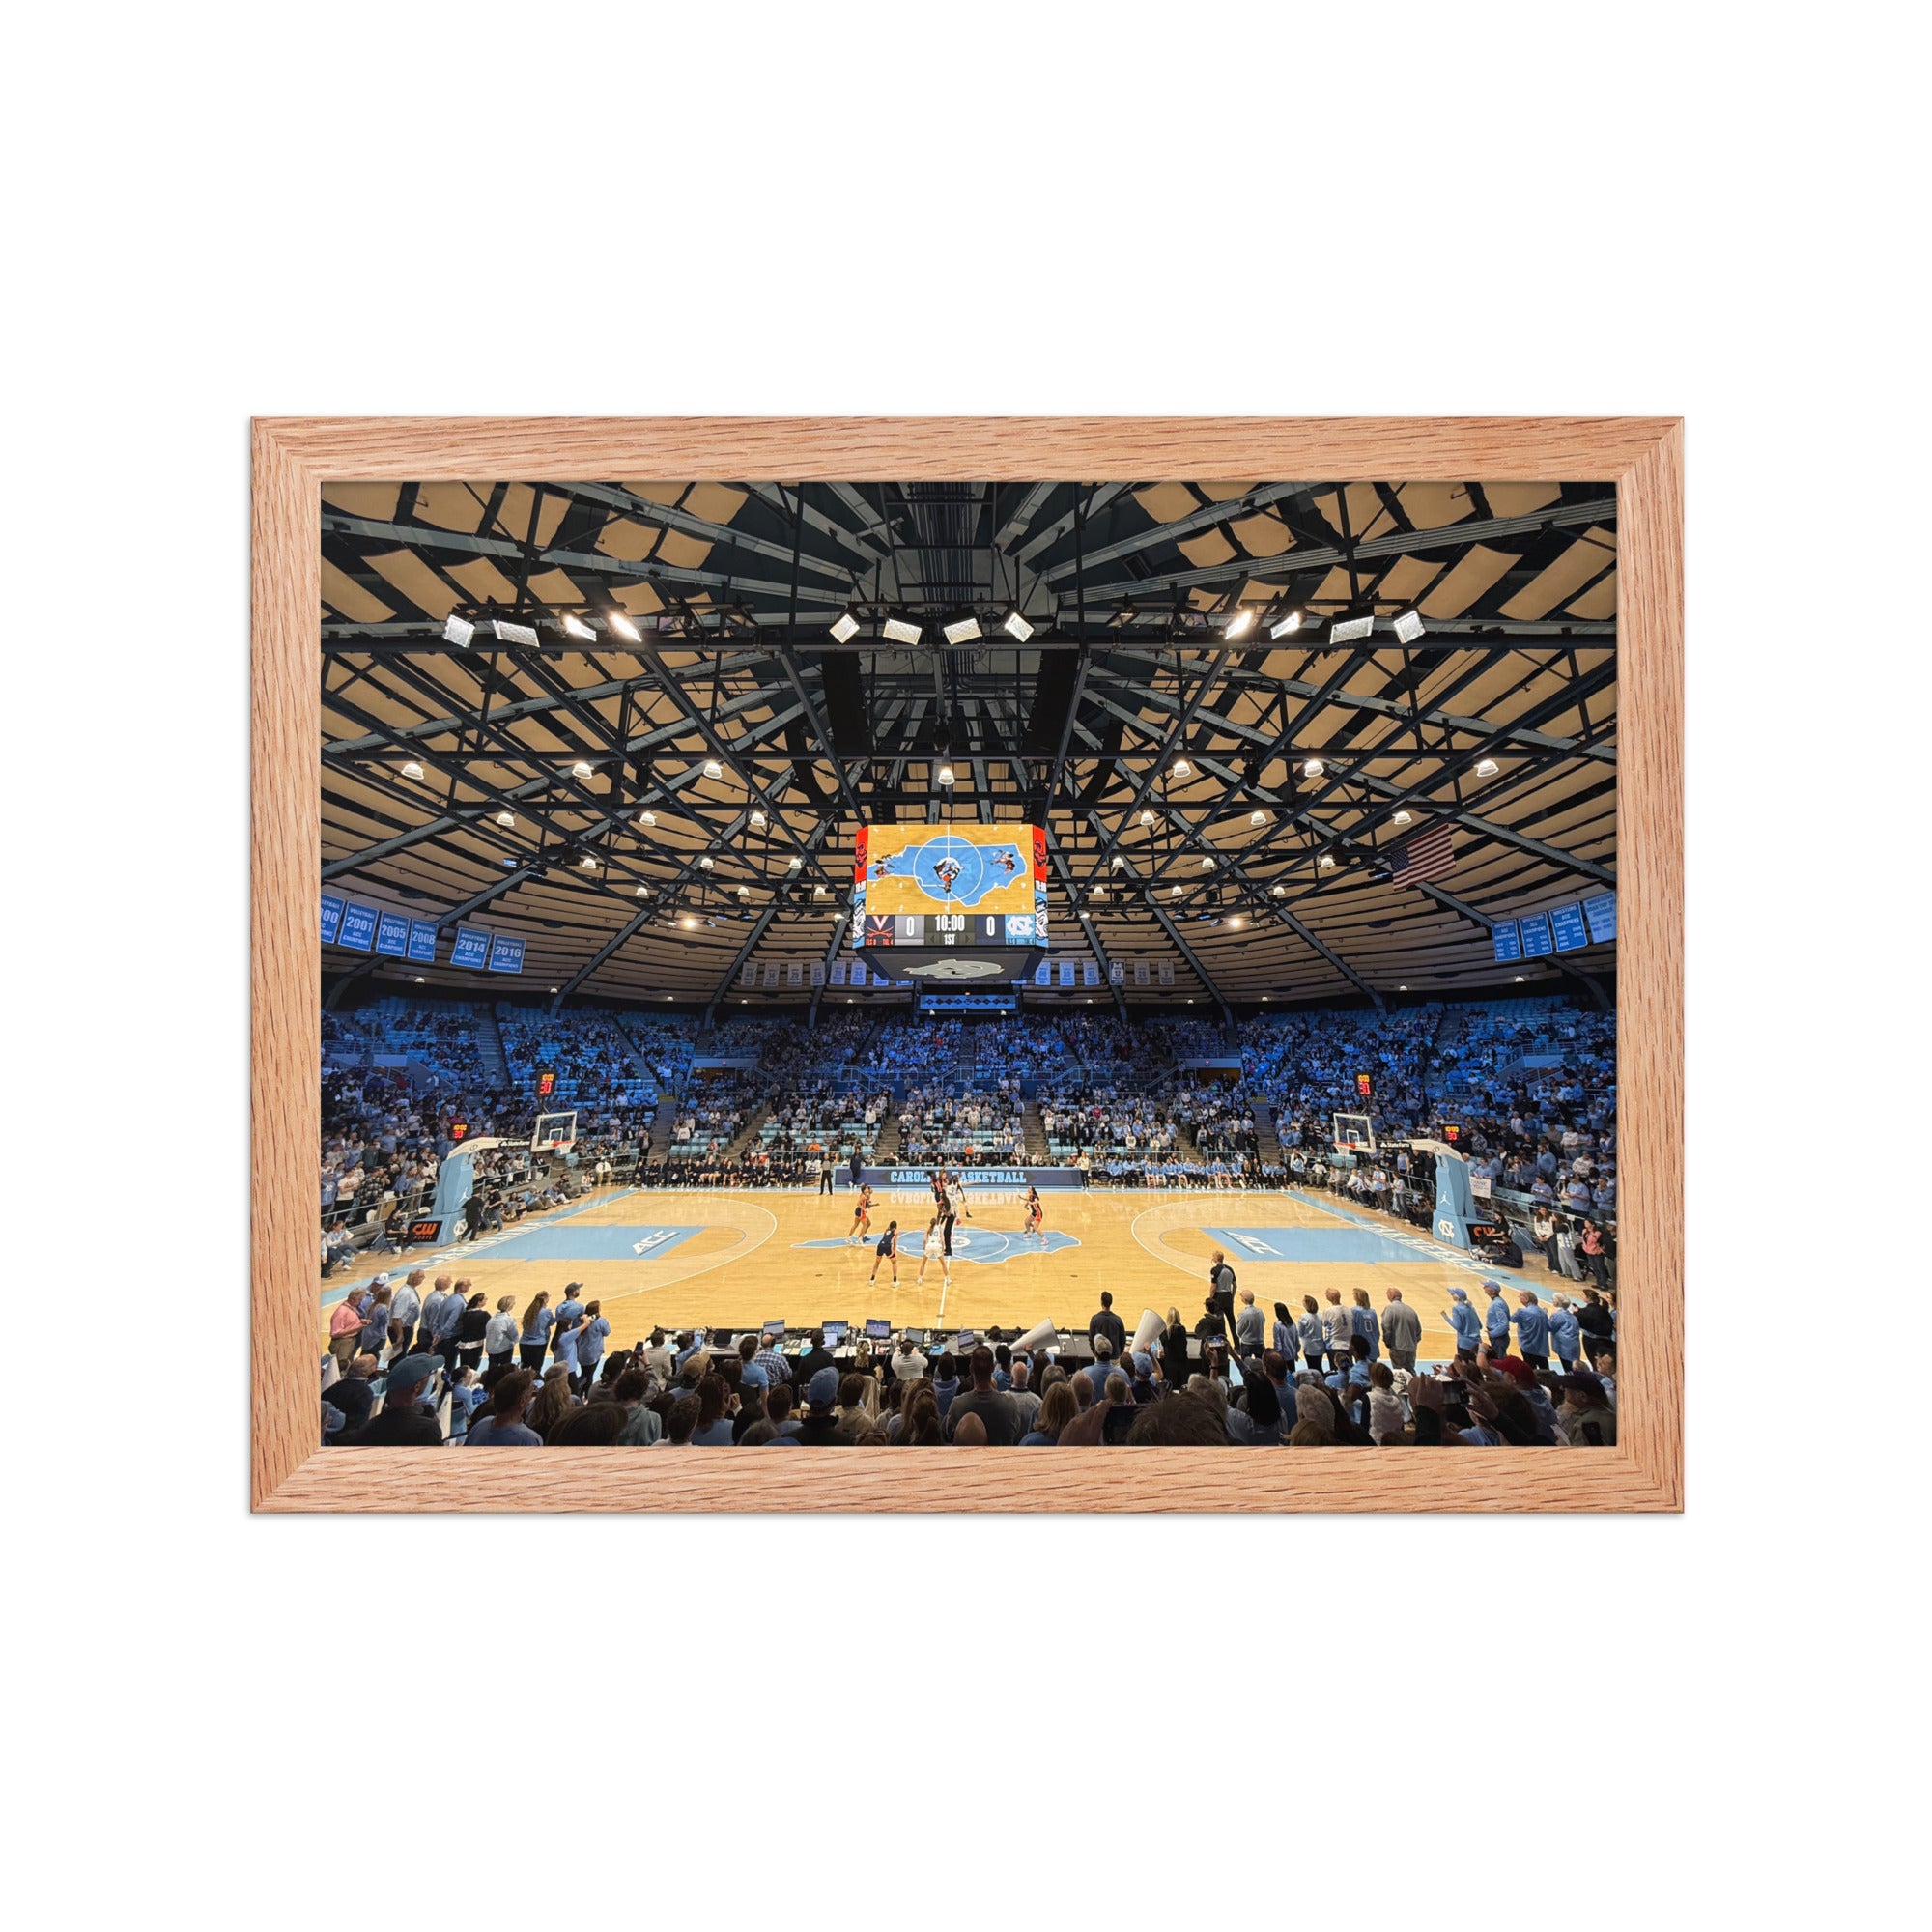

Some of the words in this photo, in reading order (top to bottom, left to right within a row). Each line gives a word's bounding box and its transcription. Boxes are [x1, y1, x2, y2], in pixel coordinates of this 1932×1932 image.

[346, 917, 373, 932] 2001
[906, 916, 915, 937] 0
[935, 914, 965, 931] 10:00
[986, 916, 995, 936] 0
[382, 924, 406, 939] 2005
[412, 931, 435, 945] 2008
[458, 940, 486, 952] 2014
[944, 934, 955, 945] 1ST
[495, 946, 521, 957] 2016
[891, 1171, 939, 1183] CAROL
[633, 1230, 678, 1255] ACC
